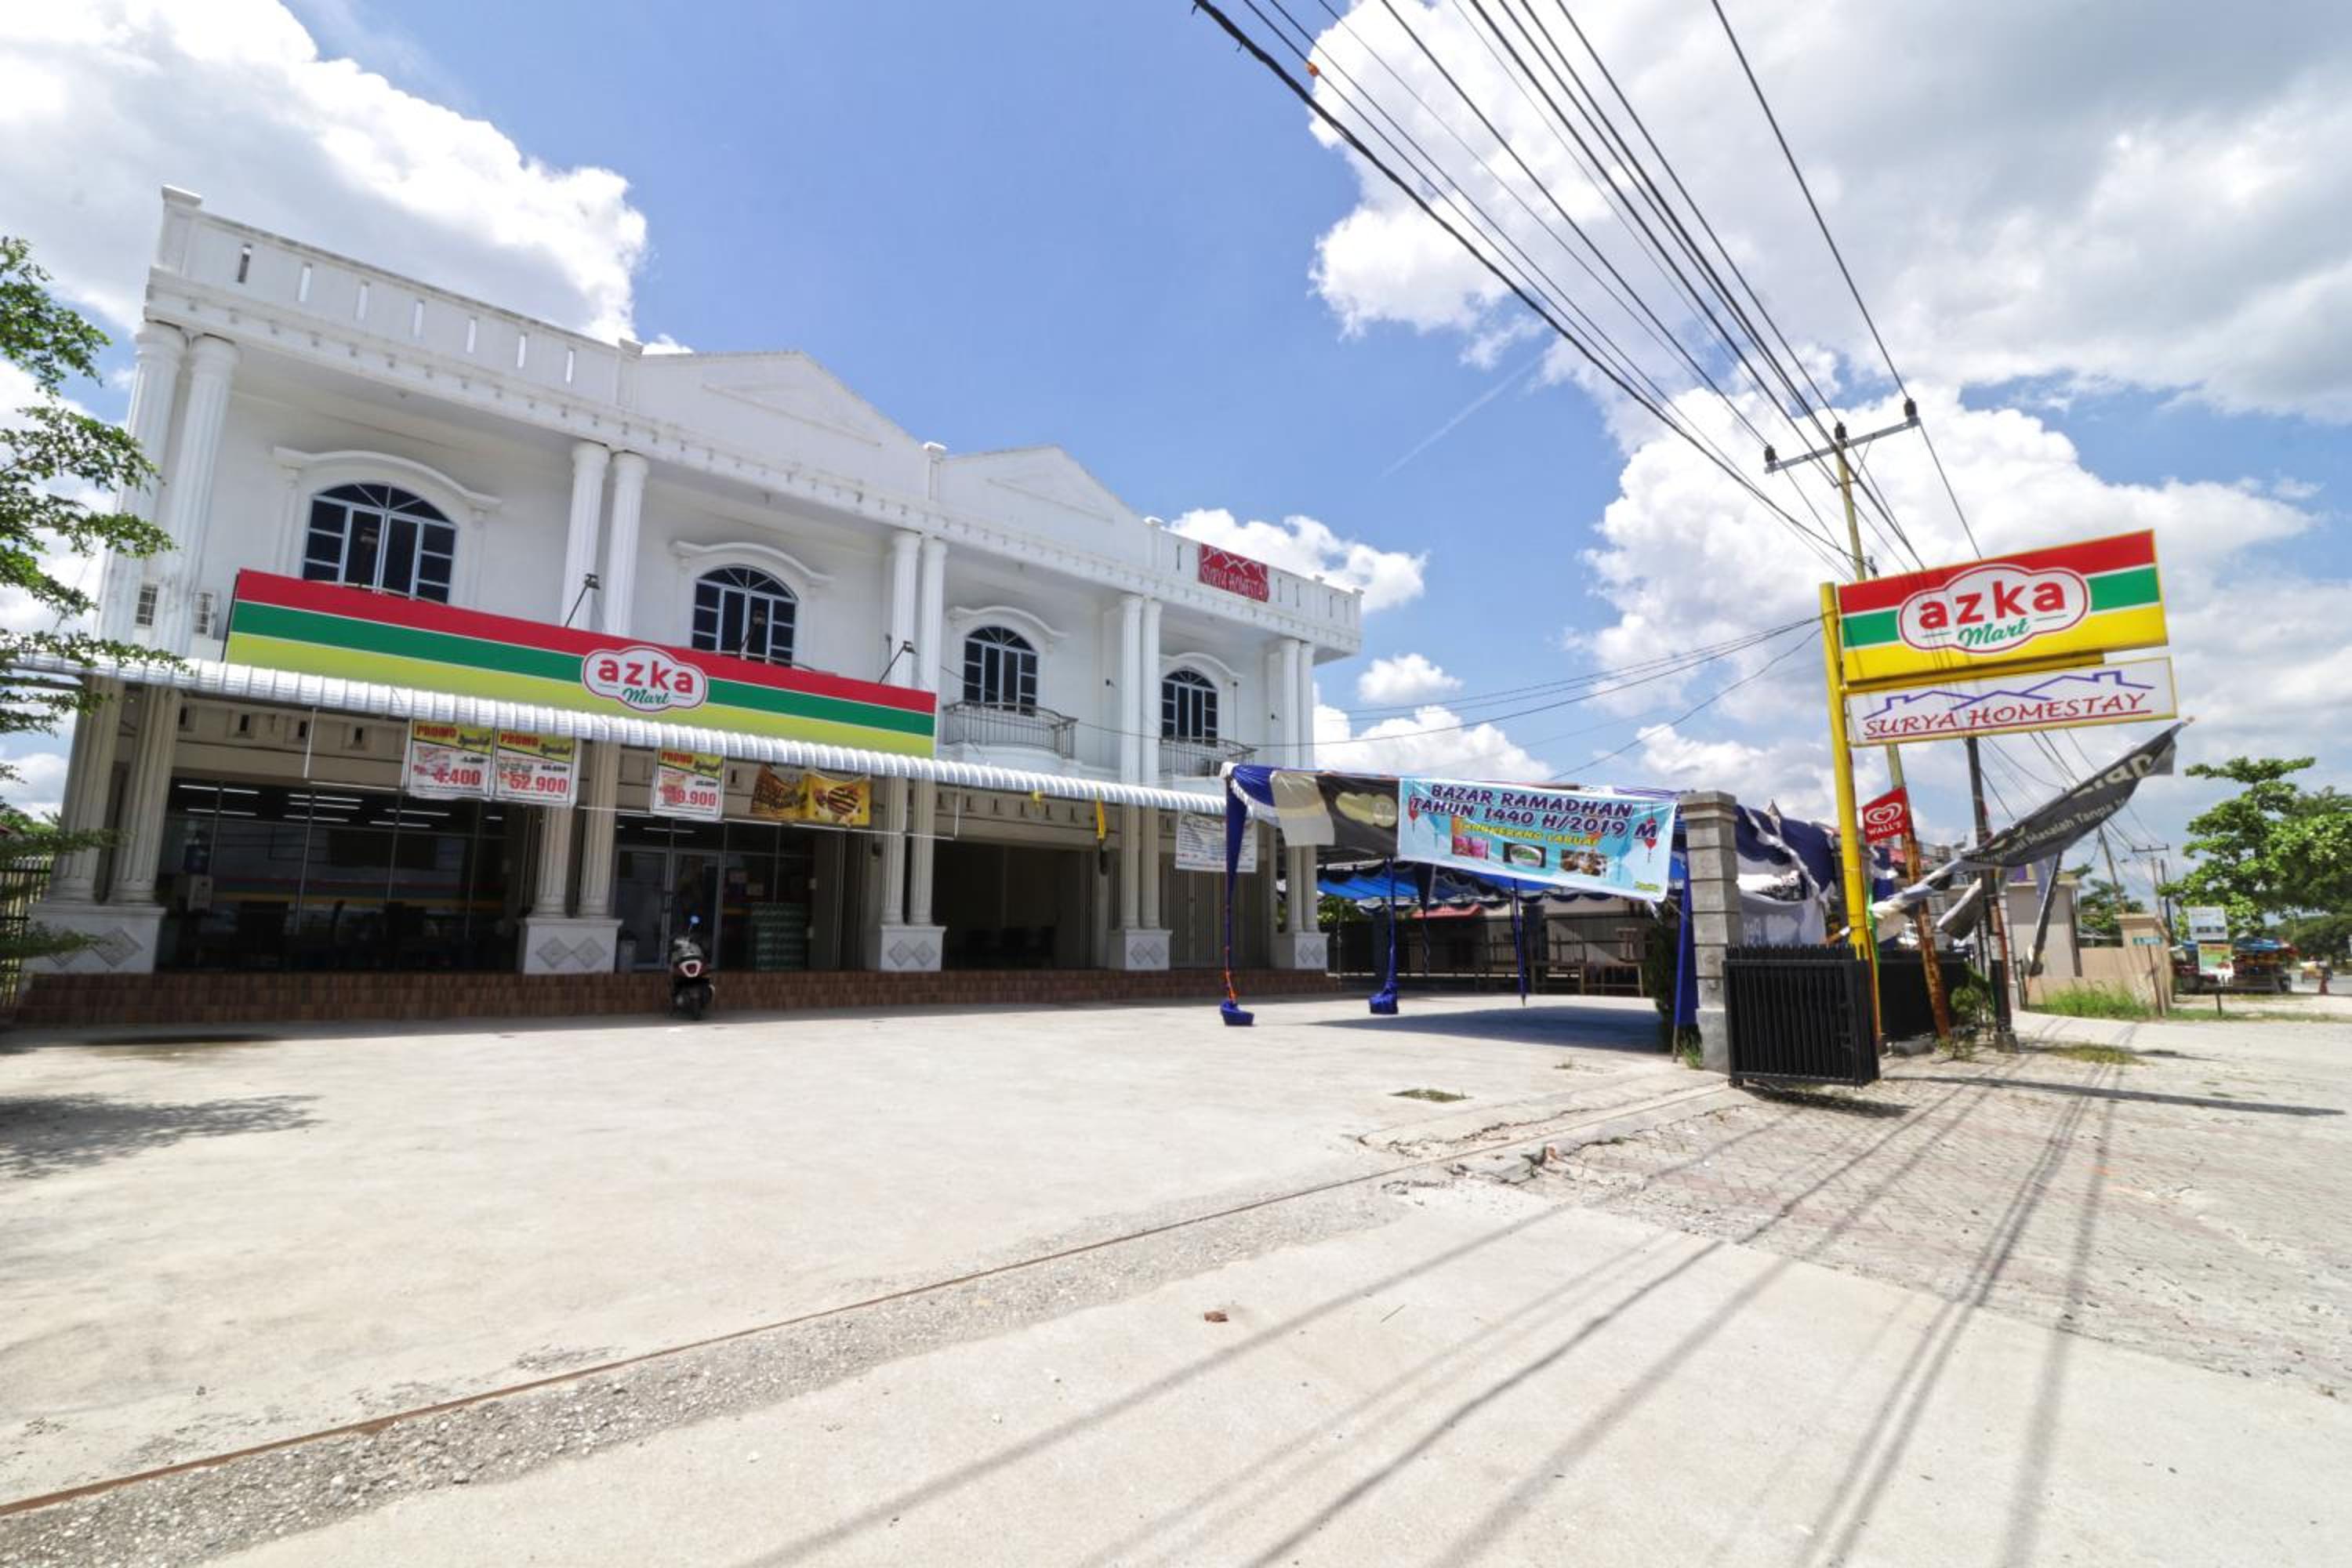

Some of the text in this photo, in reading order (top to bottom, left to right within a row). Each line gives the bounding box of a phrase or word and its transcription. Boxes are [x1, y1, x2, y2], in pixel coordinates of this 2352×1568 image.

[1919, 580, 2066, 630] azka
[1958, 618, 2031, 647] Mart
[597, 659, 695, 694] azka
[622, 687, 670, 704] Mart
[1864, 693, 2145, 736] SURYA HOMESTAY
[416, 725, 457, 738] PROMO
[499, 731, 539, 746] PROMO
[661, 750, 694, 764] PROMO
[433, 765, 482, 786] 4.400
[1431, 785, 1634, 818] BAZAR RAMADHAN
[1412, 798, 1475, 816] TAHUN
[1484, 807, 1534, 824] 1440
[1542, 816, 1627, 836] H/2019
[1635, 823, 1658, 838] M
[1867, 821, 1902, 836] WALL'S
